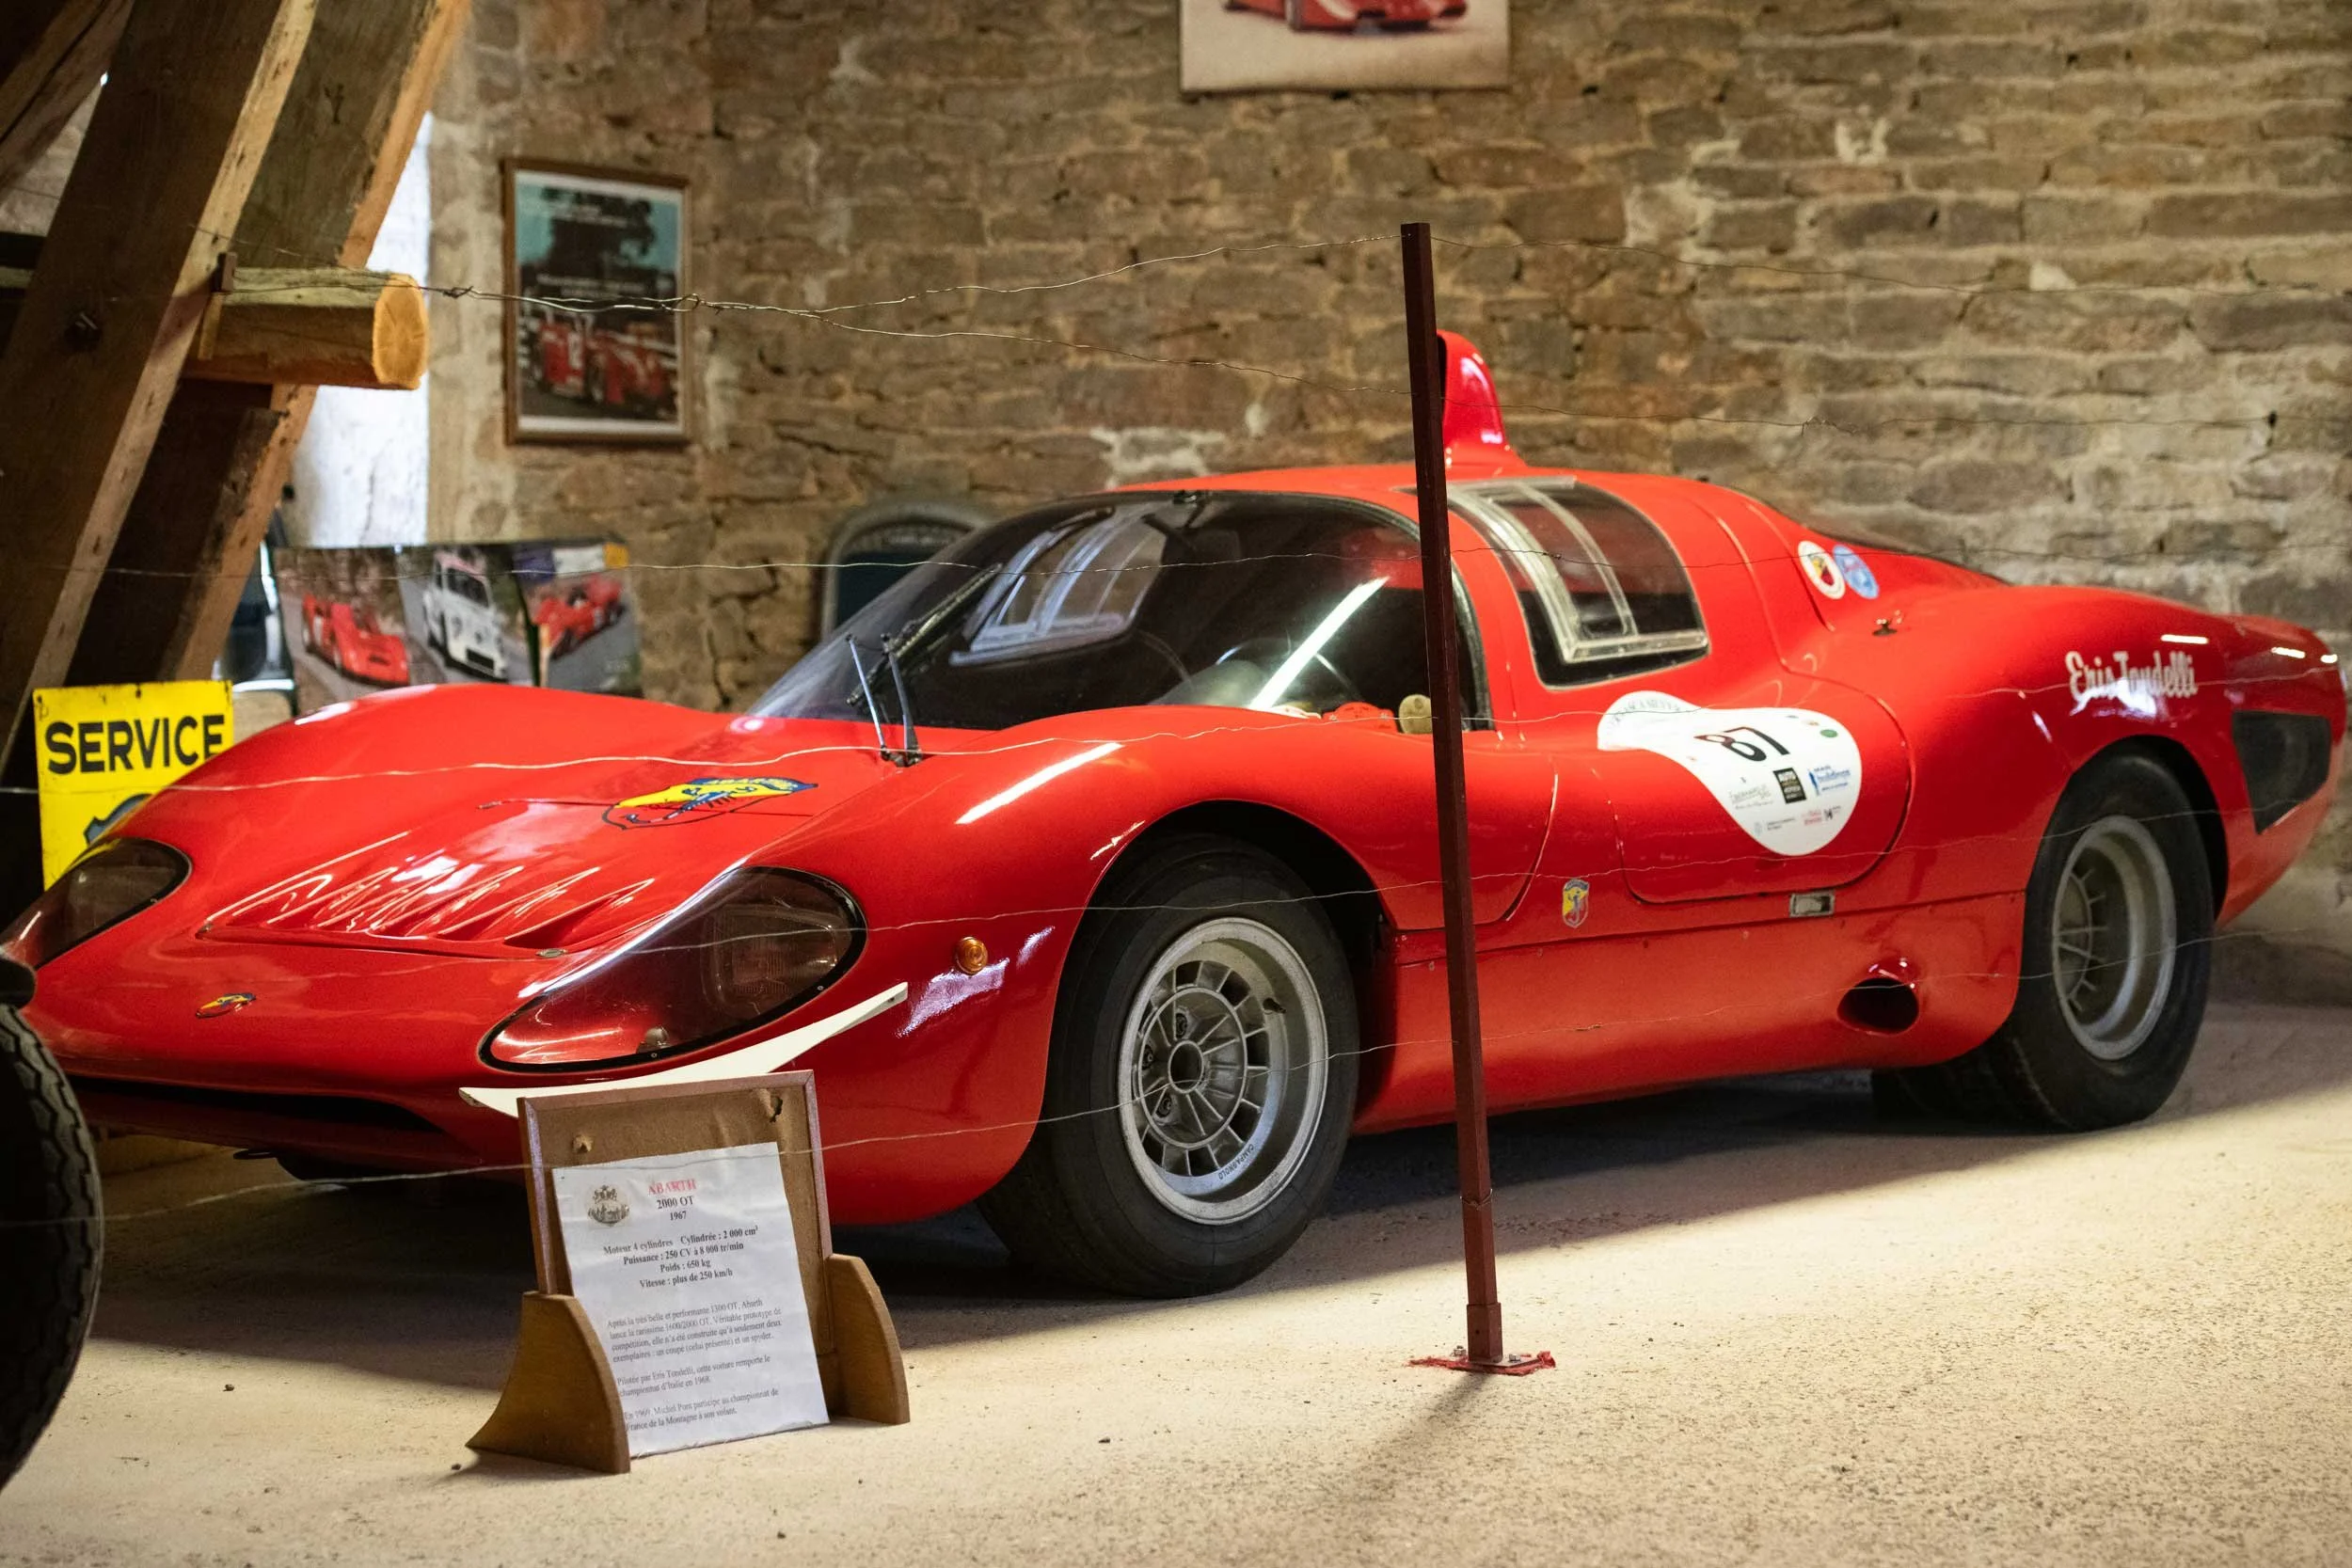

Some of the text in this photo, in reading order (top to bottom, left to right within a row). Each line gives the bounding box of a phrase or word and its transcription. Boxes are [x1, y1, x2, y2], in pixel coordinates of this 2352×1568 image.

[44, 714, 225, 775] SERVICE
[1693, 726, 1789, 762] 87
[657, 1196, 693, 1209] 2000 OT
[670, 1211, 686, 1221] 1967
[603, 1243, 631, 1256] Moteur
[633, 1243, 638, 1251] 4
[640, 1240, 674, 1252] cylindres
[680, 1231, 717, 1245] Cylindrée
[723, 1229, 728, 1240] 2
[729, 1228, 743, 1239] 000
[623, 1255, 659, 1265] Puissance
[665, 1250, 678, 1260] 250
[679, 1248, 691, 1258] CV
[699, 1245, 705, 1255] 8
[706, 1244, 719, 1254] 000
[721, 1241, 744, 1253] tr/min
[660, 1262, 681, 1273] Poids
[687, 1259, 700, 1269] 650
[701, 1259, 711, 1268] kg
[640, 1278, 666, 1289] Vitesse
[672, 1274, 688, 1287] plus
[689, 1273, 699, 1282] de
[700, 1271, 713, 1281] 250
[714, 1267, 734, 1278] km/h
